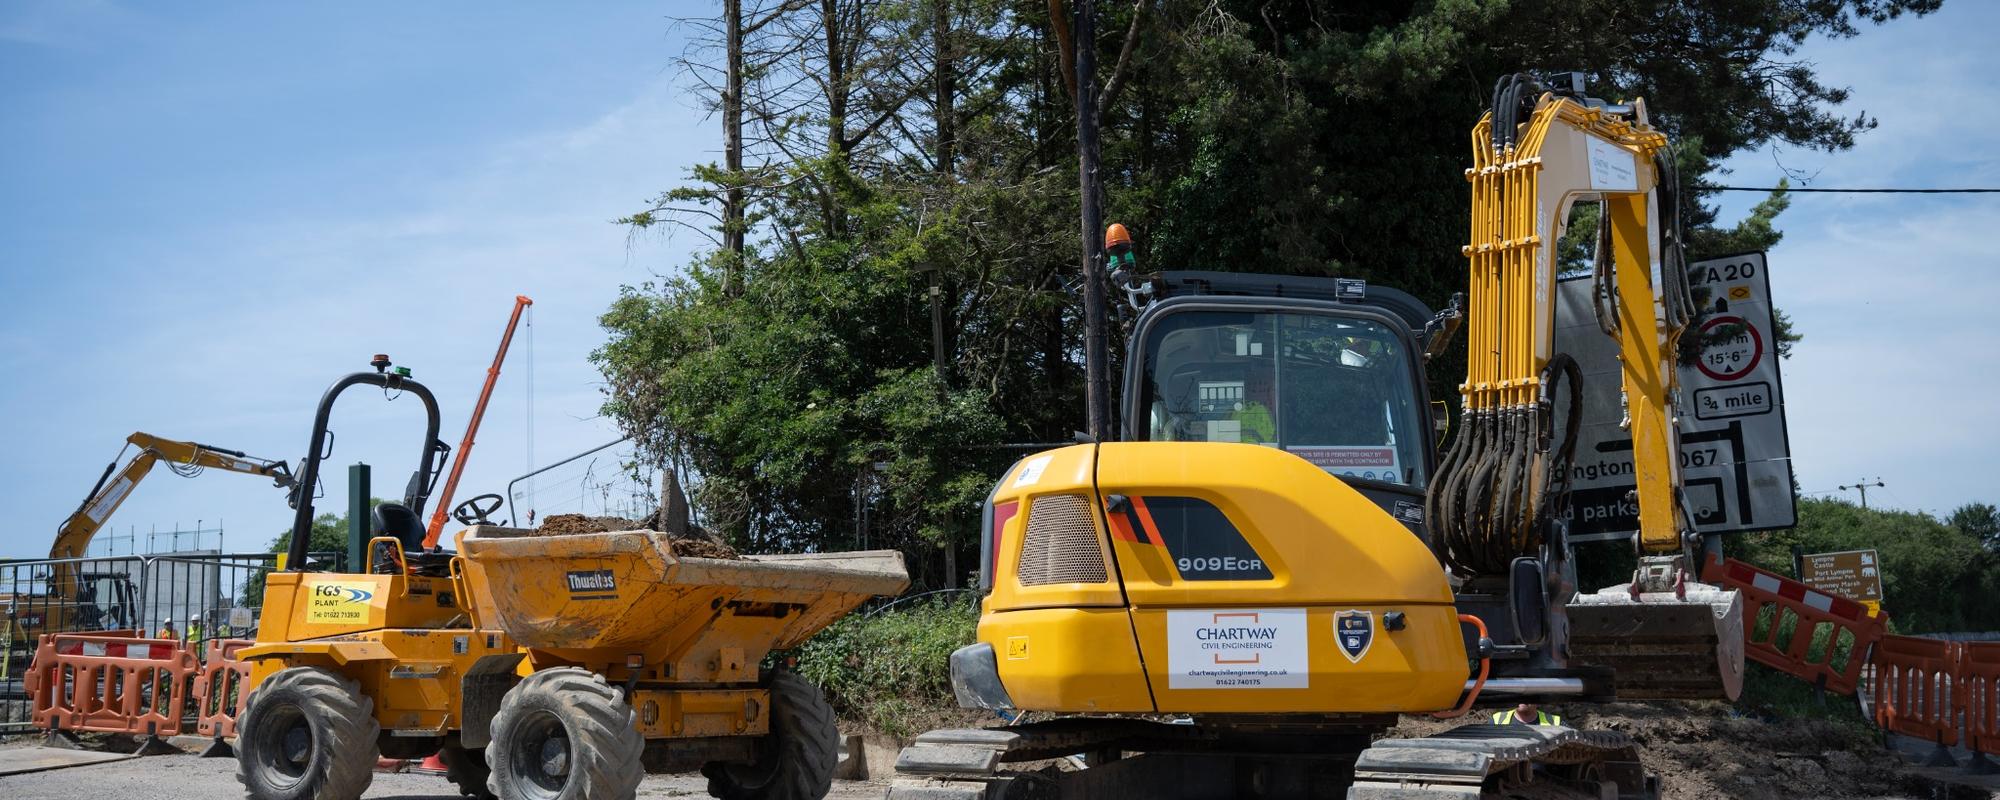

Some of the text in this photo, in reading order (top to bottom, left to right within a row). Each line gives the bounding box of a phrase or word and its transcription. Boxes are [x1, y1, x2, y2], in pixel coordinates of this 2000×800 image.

[1706, 262, 1755, 284] A20
[1725, 392, 1763, 407] mile
[1680, 448, 1718, 468] 067
[1583, 500, 1639, 522] parks
[316, 585, 342, 597] FGS
[1196, 627, 1278, 641] CHARTWAY
[1201, 641, 1273, 650] CIVIL ENGINEERING
[1188, 668, 1288, 678] chartwaycivilengineering.co.uk
